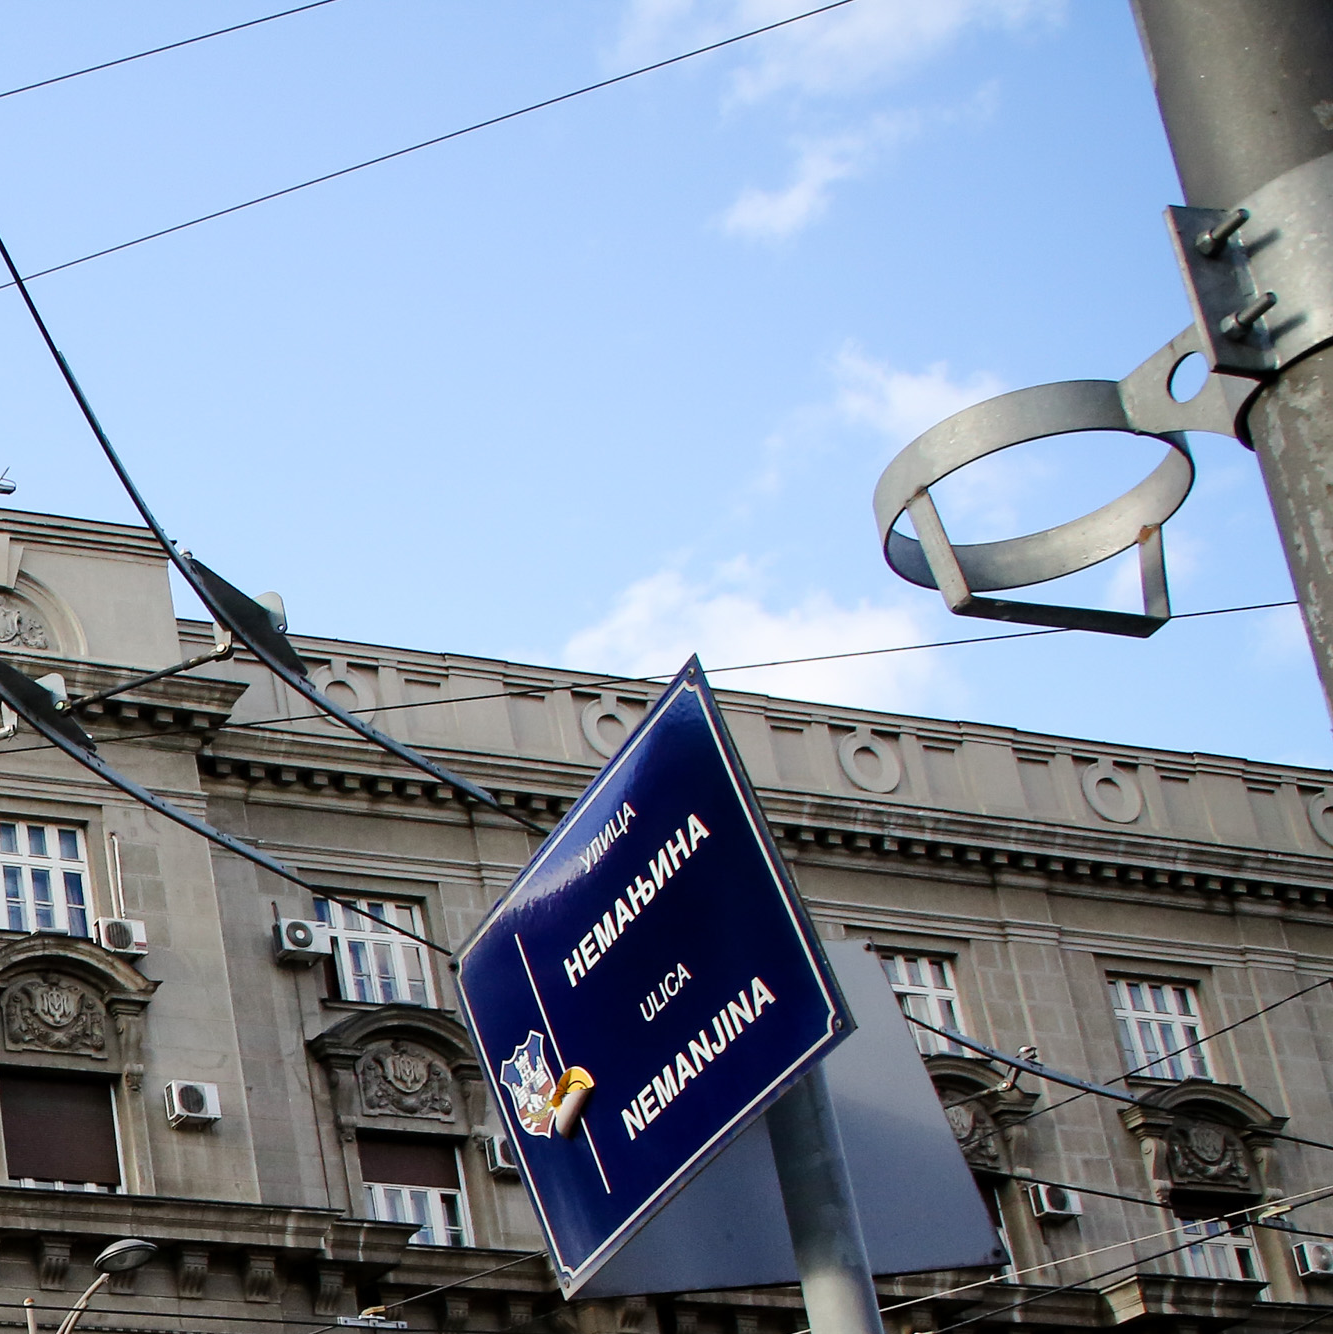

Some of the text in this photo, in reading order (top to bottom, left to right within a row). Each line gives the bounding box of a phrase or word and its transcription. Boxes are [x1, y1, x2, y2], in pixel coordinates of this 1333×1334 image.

[579, 802, 636, 873] УЛИЦА
[563, 813, 710, 986] НЕМАЊИНА
[639, 963, 692, 1022] ULICA
[621, 977, 776, 1140] NEMANJINA
